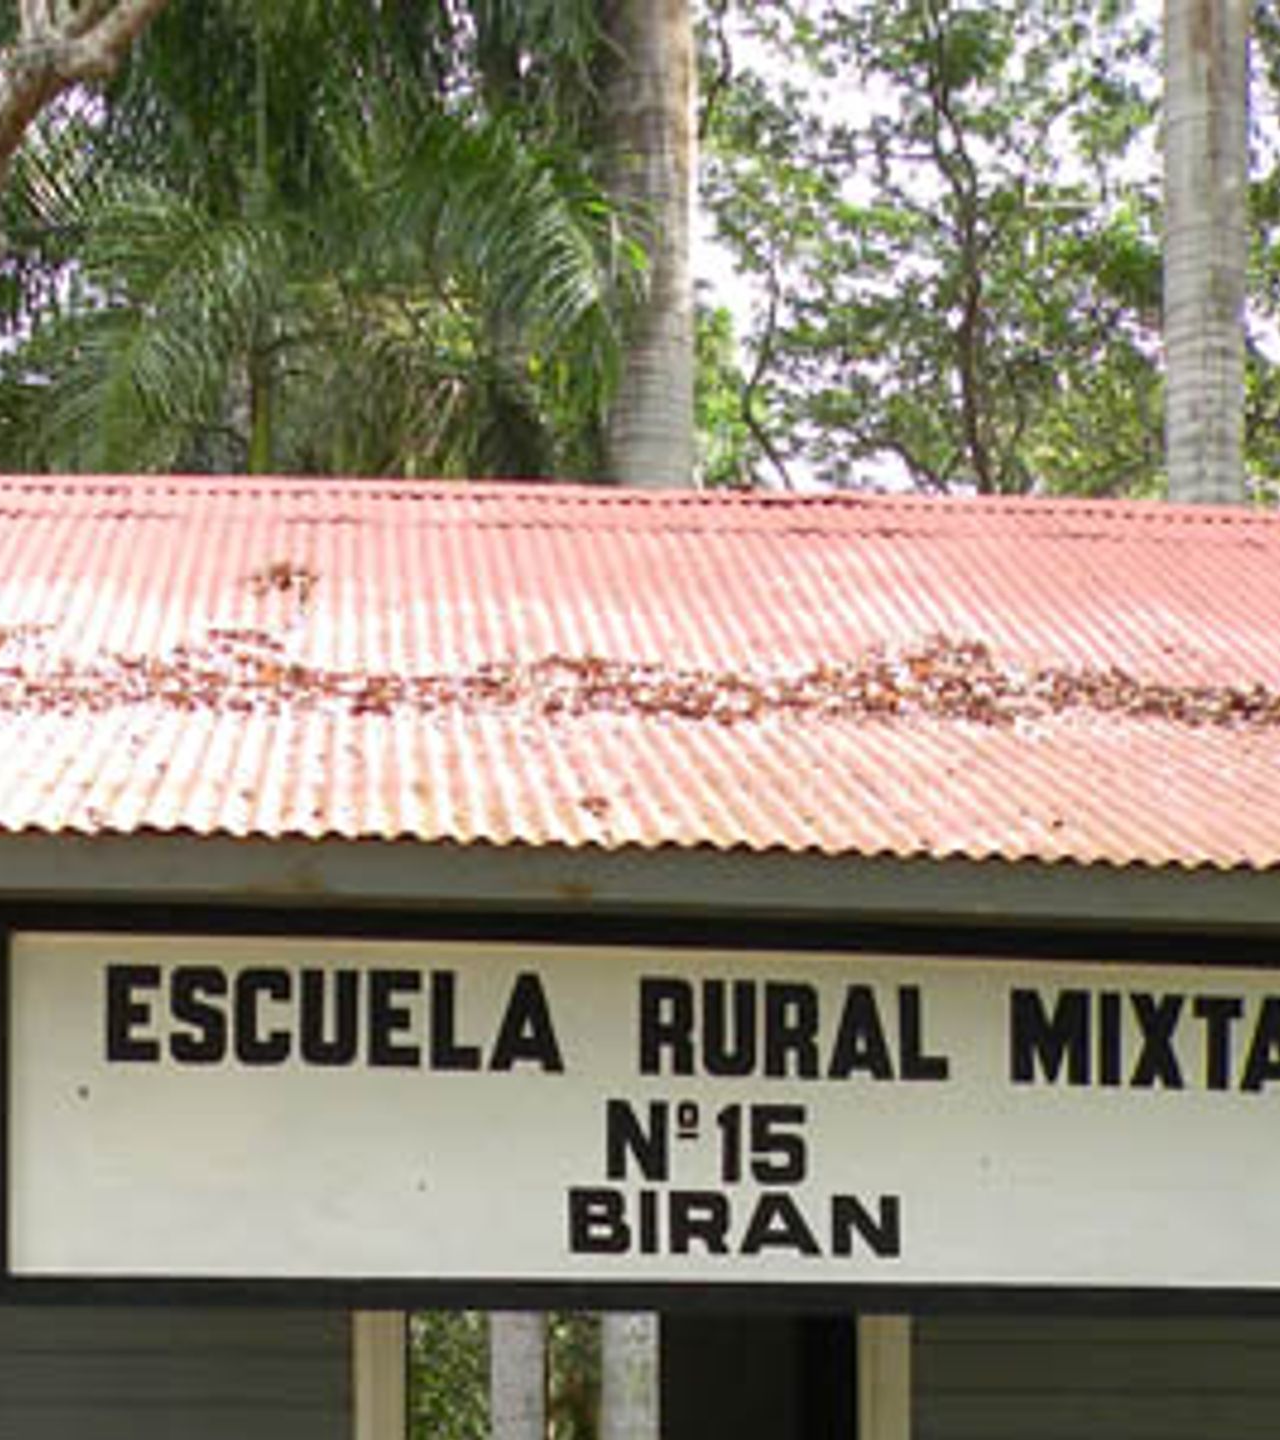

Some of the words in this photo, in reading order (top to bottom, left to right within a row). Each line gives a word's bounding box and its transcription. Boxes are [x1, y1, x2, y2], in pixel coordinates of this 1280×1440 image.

[104, 962, 565, 1075] ESCUELA
[638, 974, 951, 1082] RURAL
[568, 1187, 900, 1258] BIRAN
